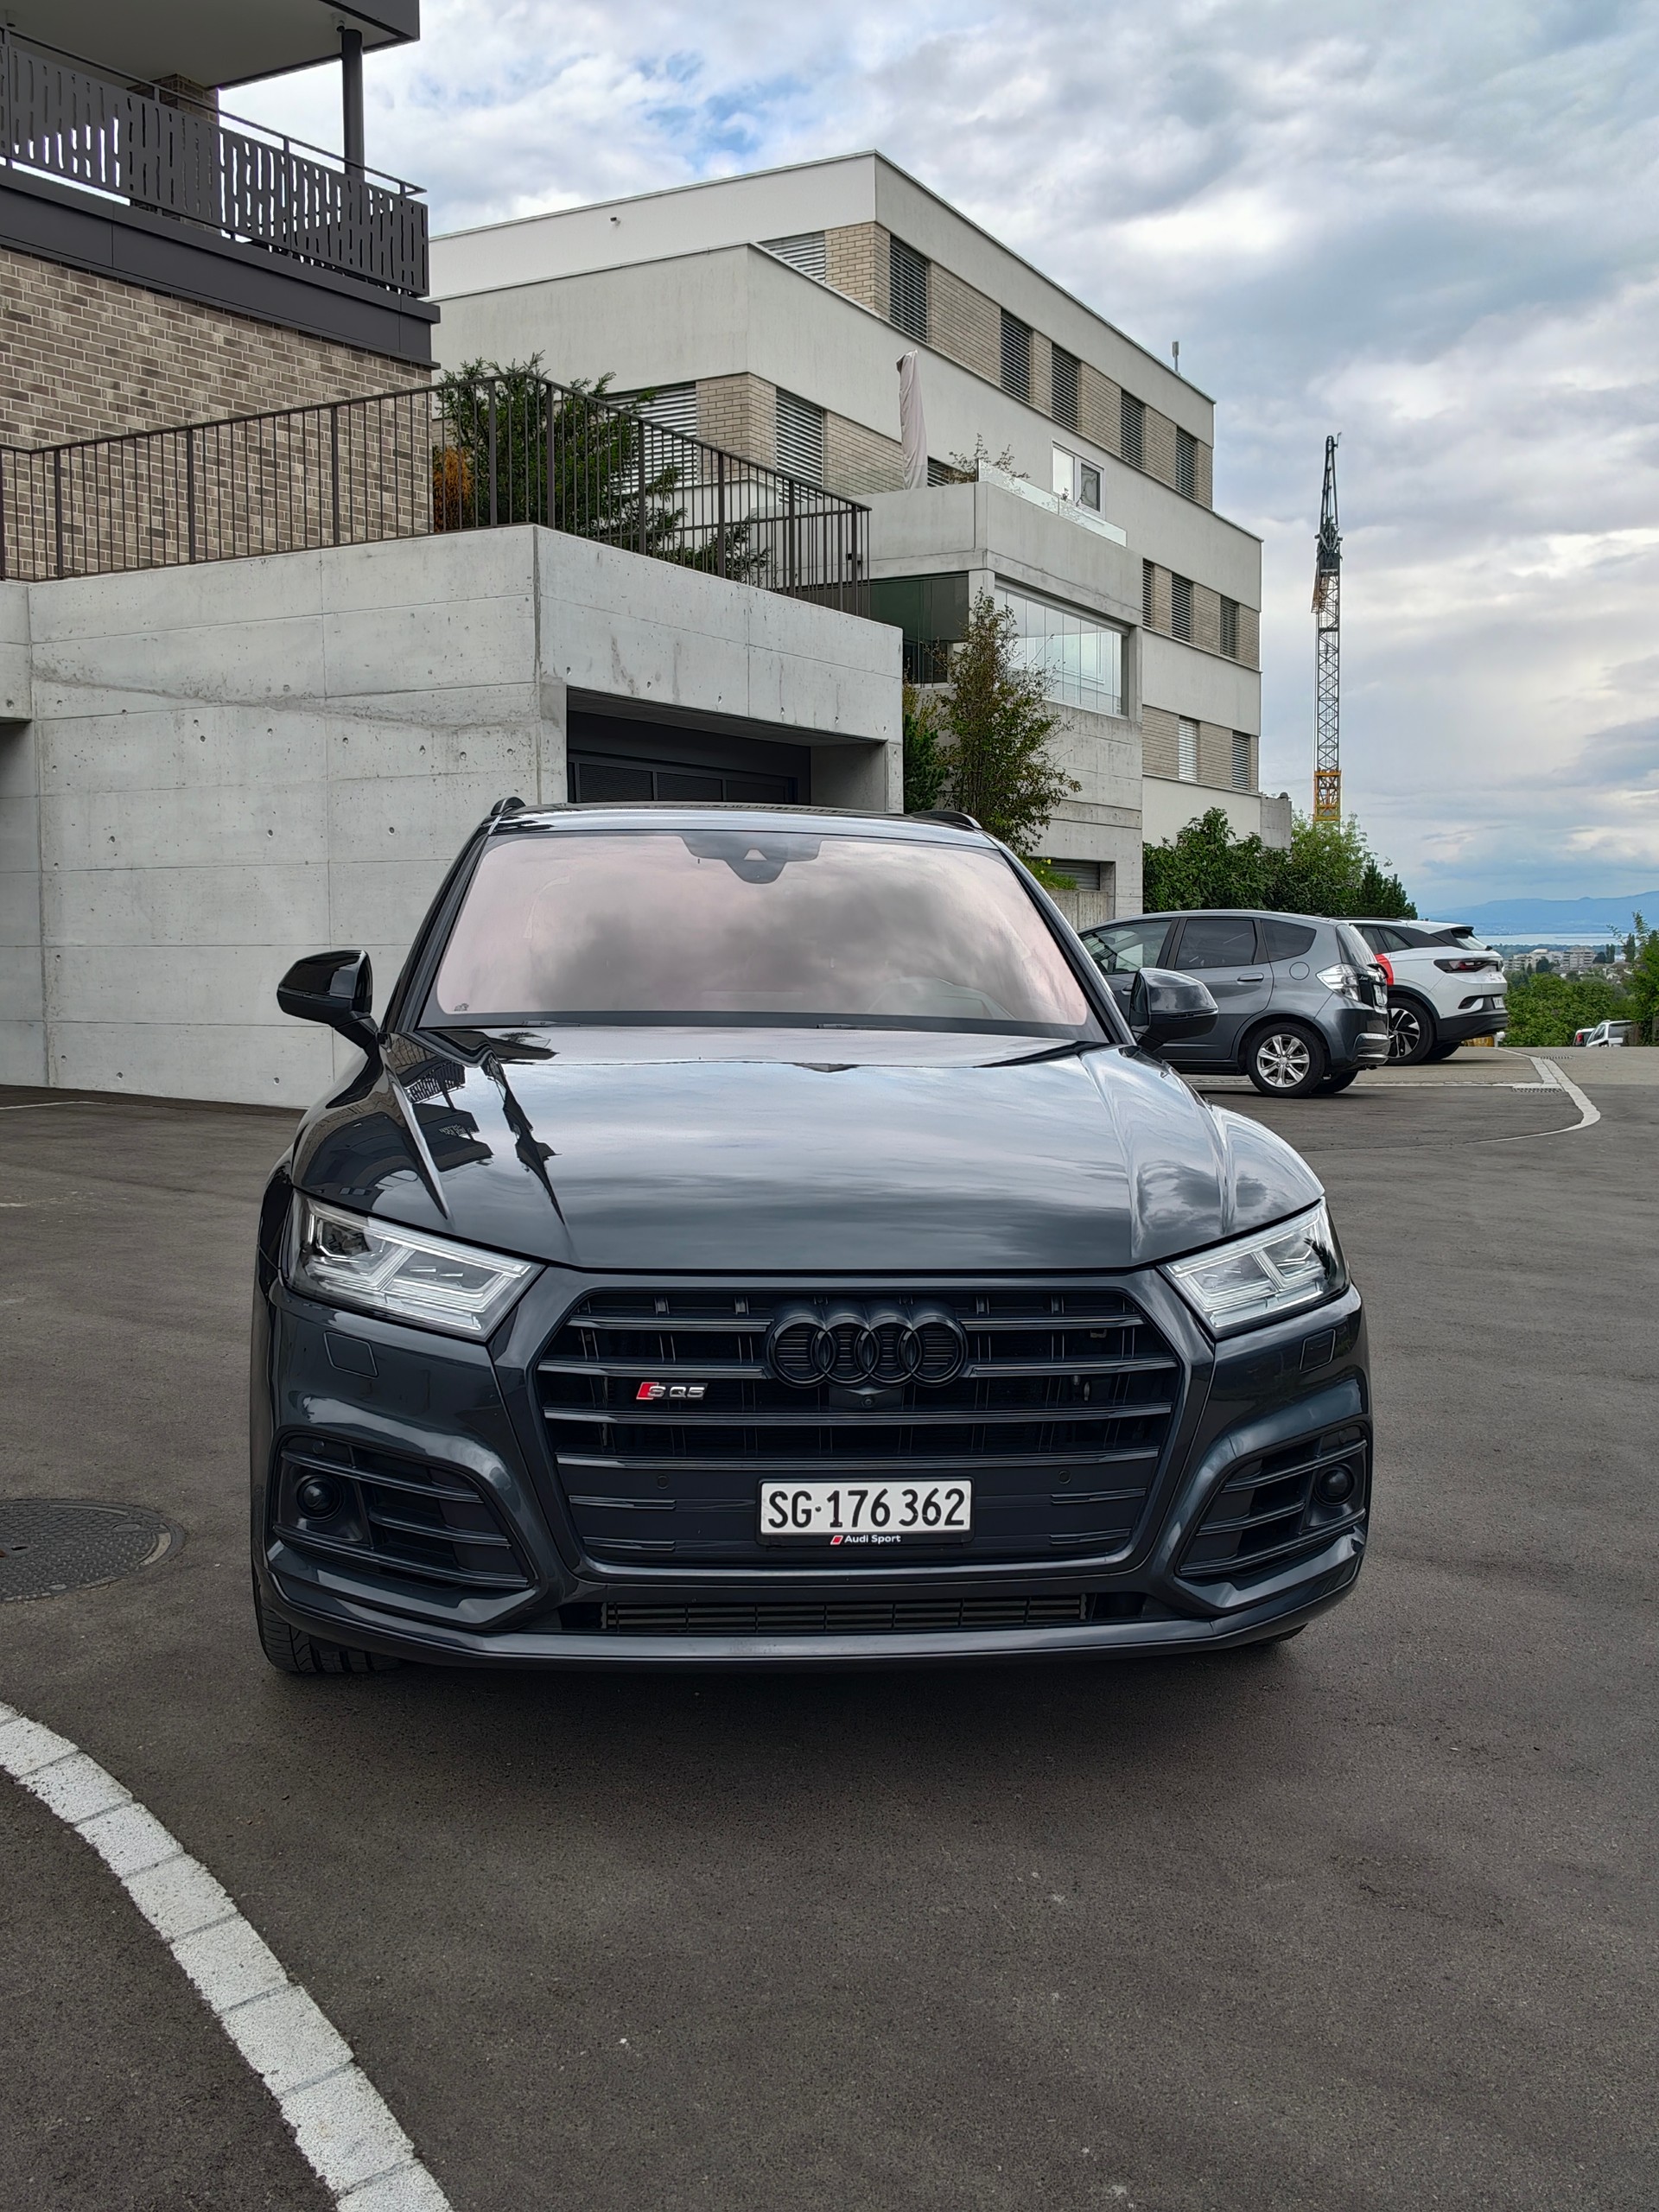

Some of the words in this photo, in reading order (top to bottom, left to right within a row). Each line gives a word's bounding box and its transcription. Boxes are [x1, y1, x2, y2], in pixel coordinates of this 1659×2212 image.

[899, 1487, 965, 1527] 362
[844, 1535, 868, 1543] Audi
[871, 1535, 901, 1545] Sport
